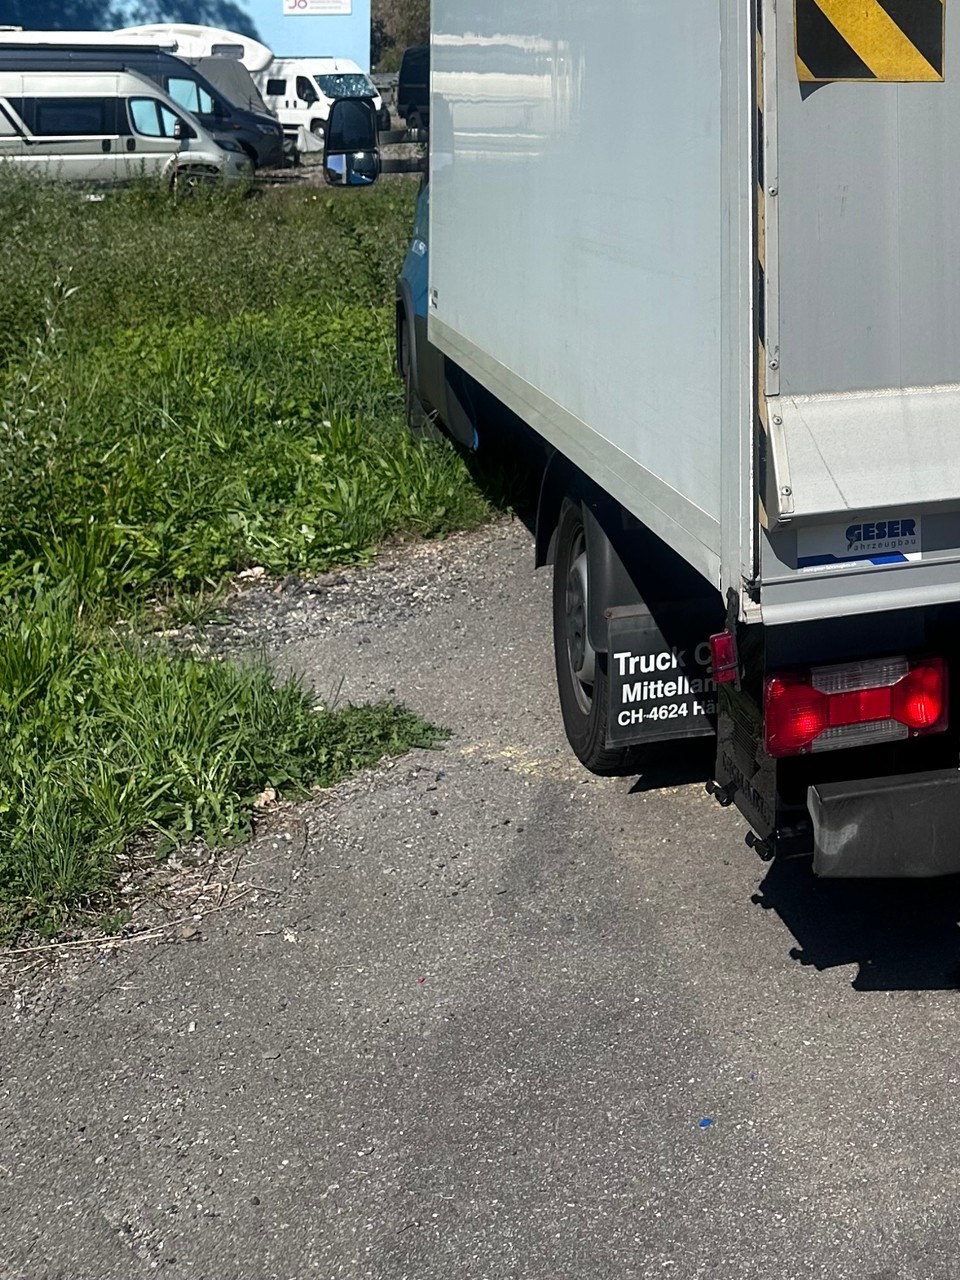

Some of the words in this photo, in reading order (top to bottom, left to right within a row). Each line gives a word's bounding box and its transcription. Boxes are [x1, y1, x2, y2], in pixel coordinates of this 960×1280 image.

[845, 518, 916, 543] GESER
[613, 646, 687, 676] Truck
[622, 675, 718, 704] Mittellan
[617, 702, 689, 727] CH-4624
